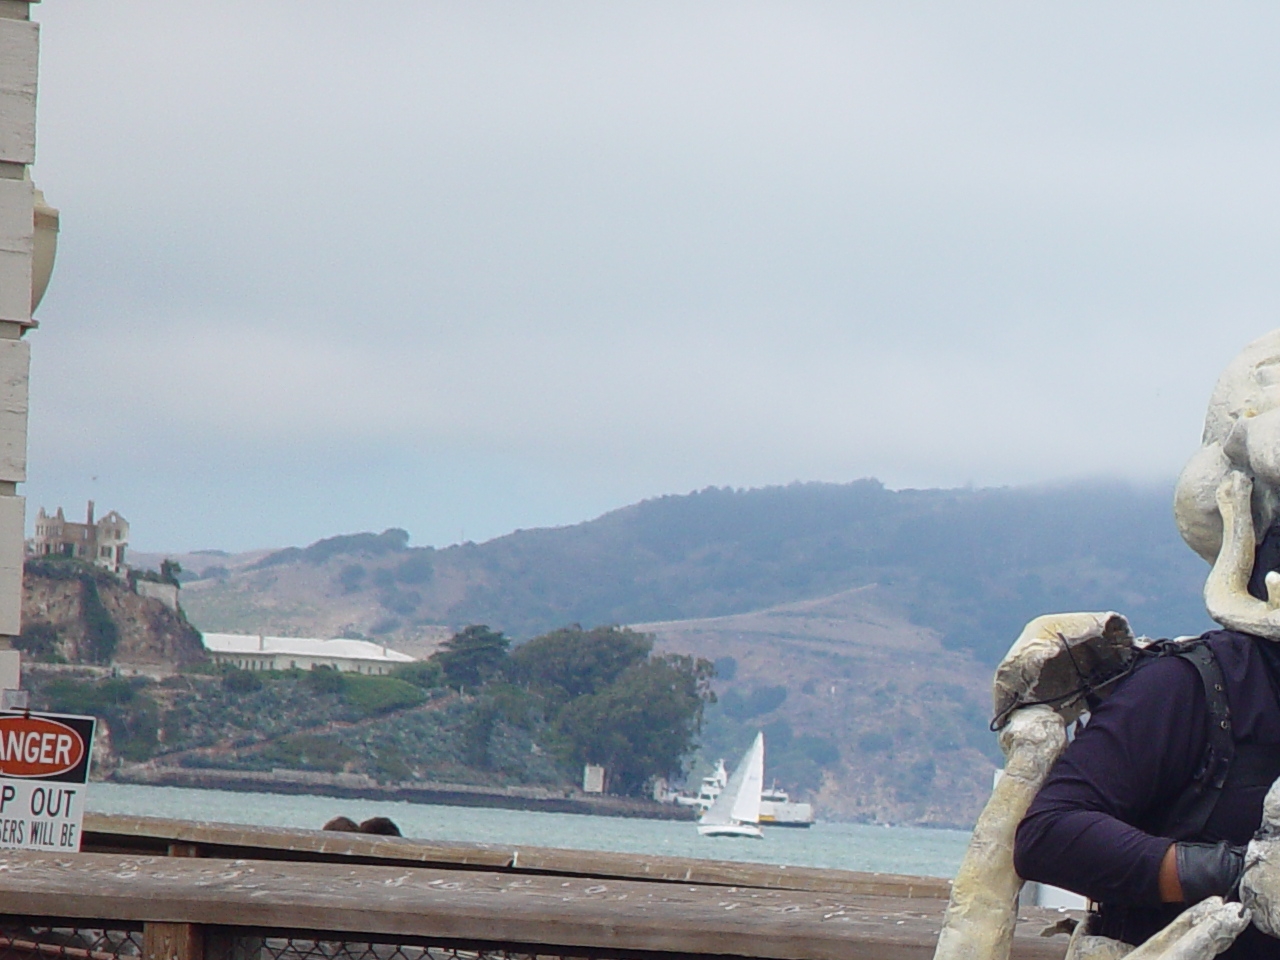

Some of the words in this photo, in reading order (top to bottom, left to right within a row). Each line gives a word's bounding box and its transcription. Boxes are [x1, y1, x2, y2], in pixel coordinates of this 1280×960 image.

[31, 788, 76, 818] OUT
[30, 821, 54, 846] WILL
[60, 823, 75, 847] BE
